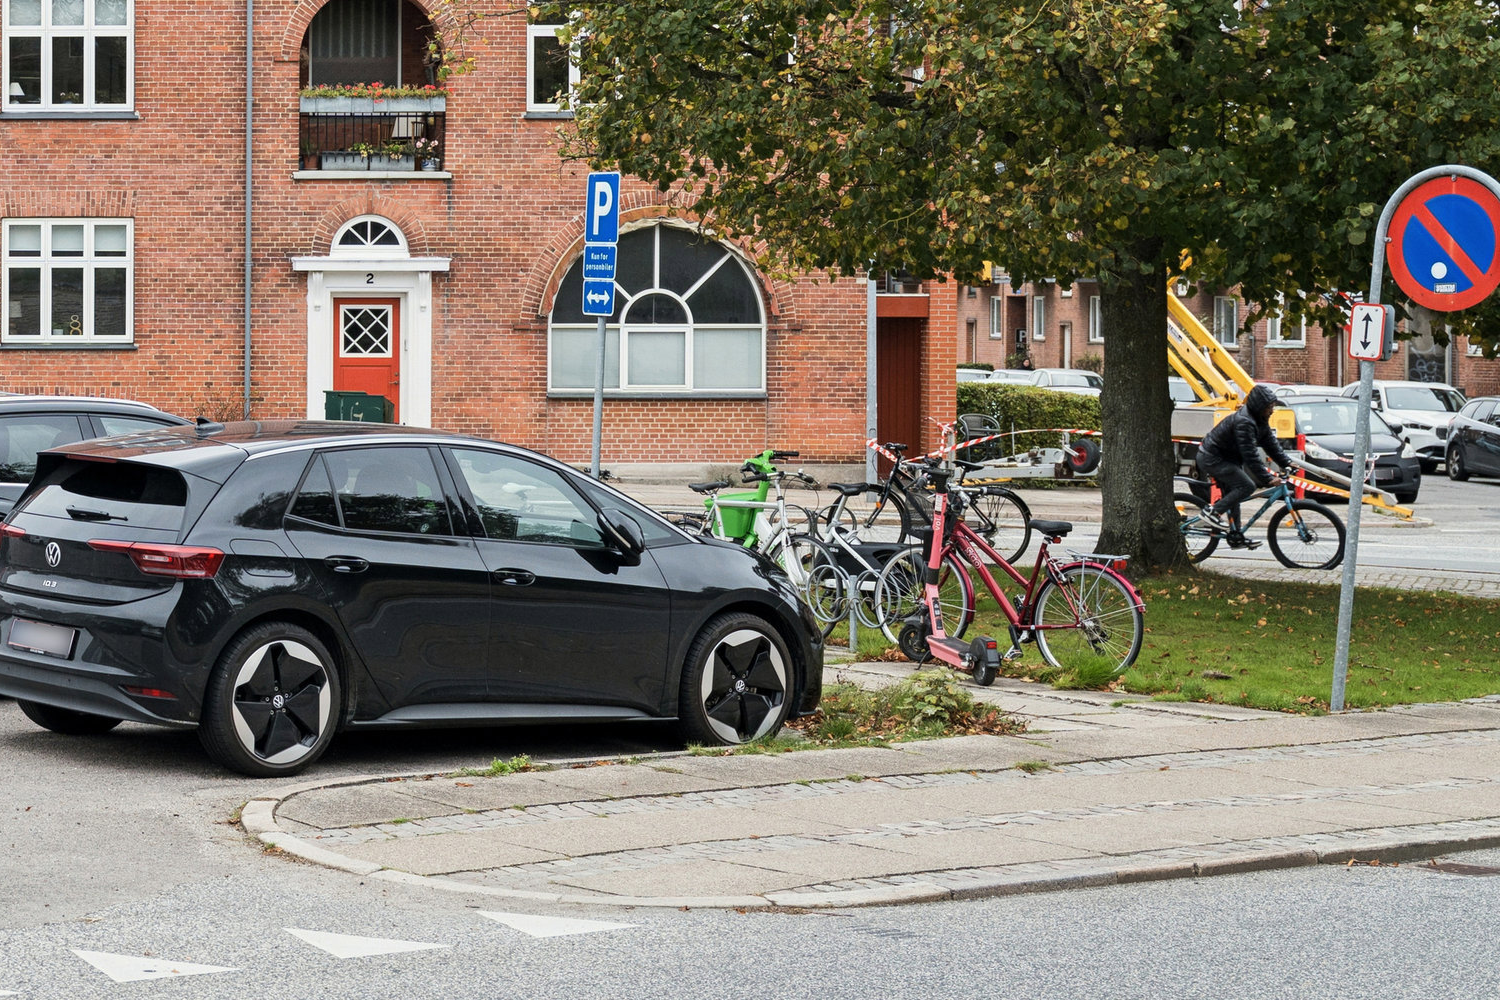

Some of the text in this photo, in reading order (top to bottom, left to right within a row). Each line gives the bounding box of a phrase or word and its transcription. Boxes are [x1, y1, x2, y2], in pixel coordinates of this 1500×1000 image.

[593, 181, 613, 235] P
[591, 252, 609, 260] Kun for
[585, 263, 614, 271] personbiler
[366, 273, 375, 284] 2
